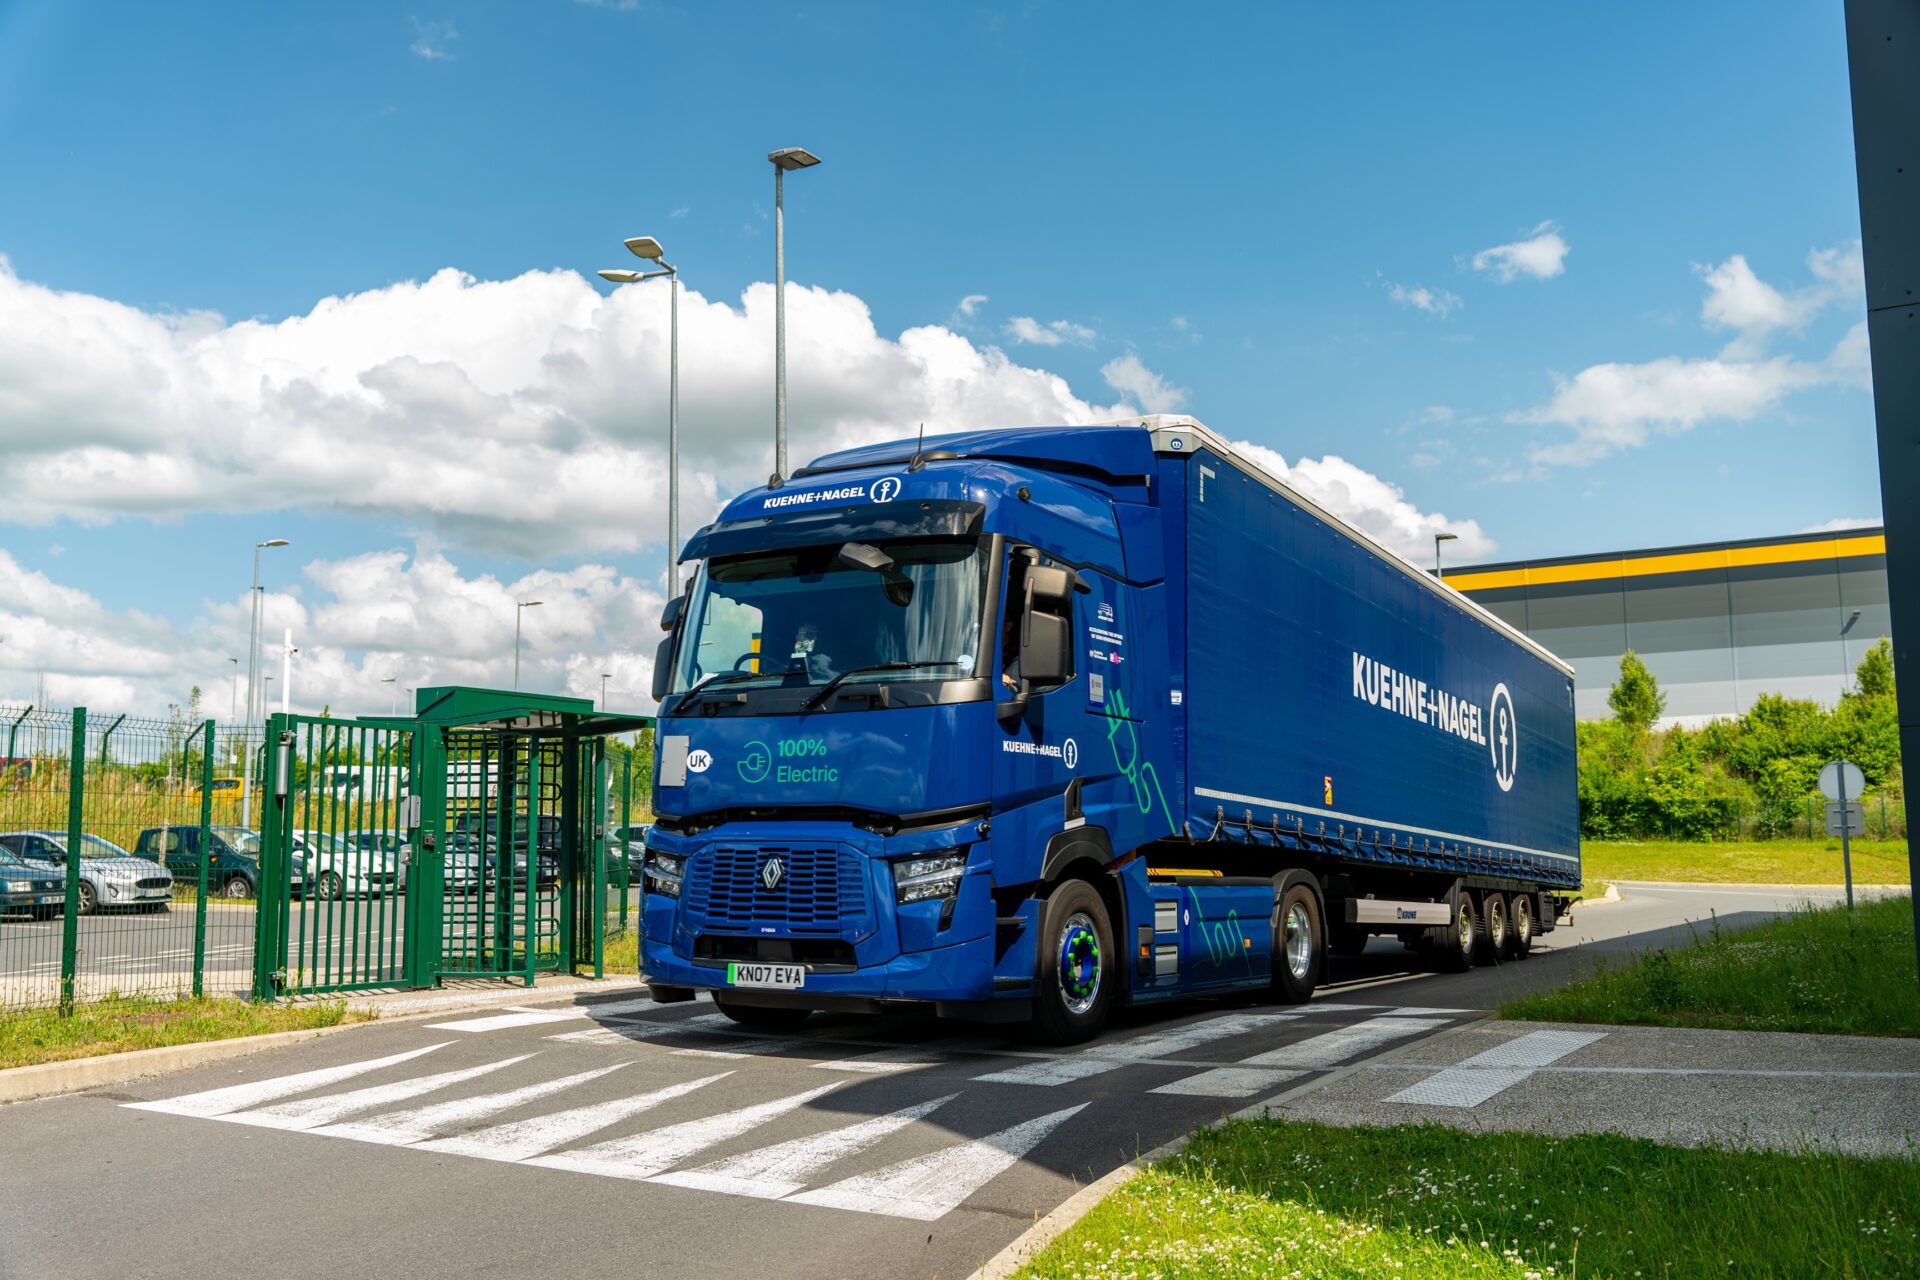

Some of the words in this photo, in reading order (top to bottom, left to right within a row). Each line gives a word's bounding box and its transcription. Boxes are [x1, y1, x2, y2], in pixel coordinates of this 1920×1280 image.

[763, 487, 866, 509] KUEHNE+NAGEL
[1352, 651, 1487, 746] KUEHNE+NAGEL
[777, 739, 827, 757] 100%
[1002, 740, 1063, 758] KUEHNE+NAGEL
[689, 754, 708, 768] UK
[777, 765, 839, 783] Electric
[737, 965, 772, 983] KN07
[775, 967, 801, 985] EVA
